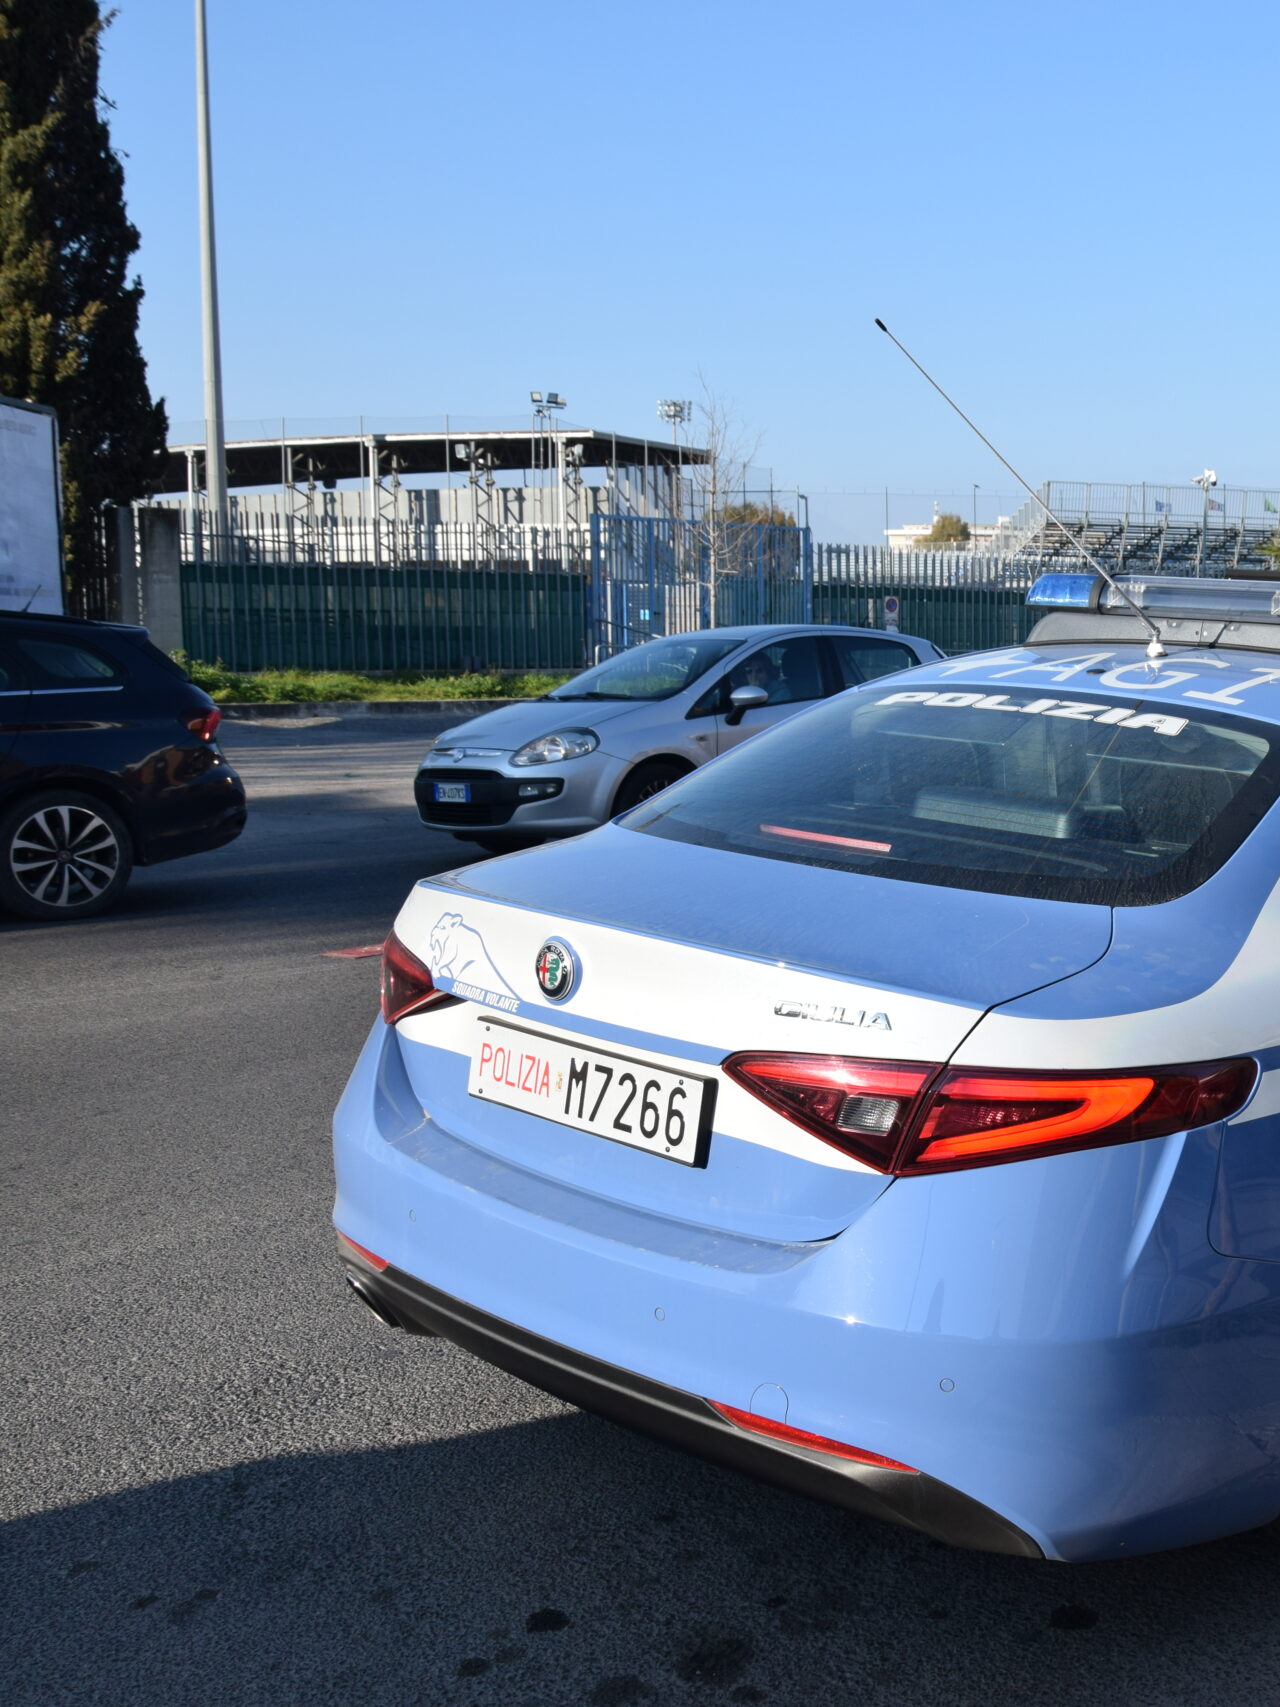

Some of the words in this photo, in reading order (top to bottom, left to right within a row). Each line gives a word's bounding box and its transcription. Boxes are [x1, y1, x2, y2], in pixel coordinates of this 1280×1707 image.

[875, 691, 1190, 737] POLIZIA
[452, 981, 486, 1003] SQUADRA
[485, 992, 520, 1013] VOLANTE
[774, 1000, 893, 1031] GIULIA
[479, 1042, 551, 1098] POLIZIA
[564, 1057, 687, 1147] M7266
